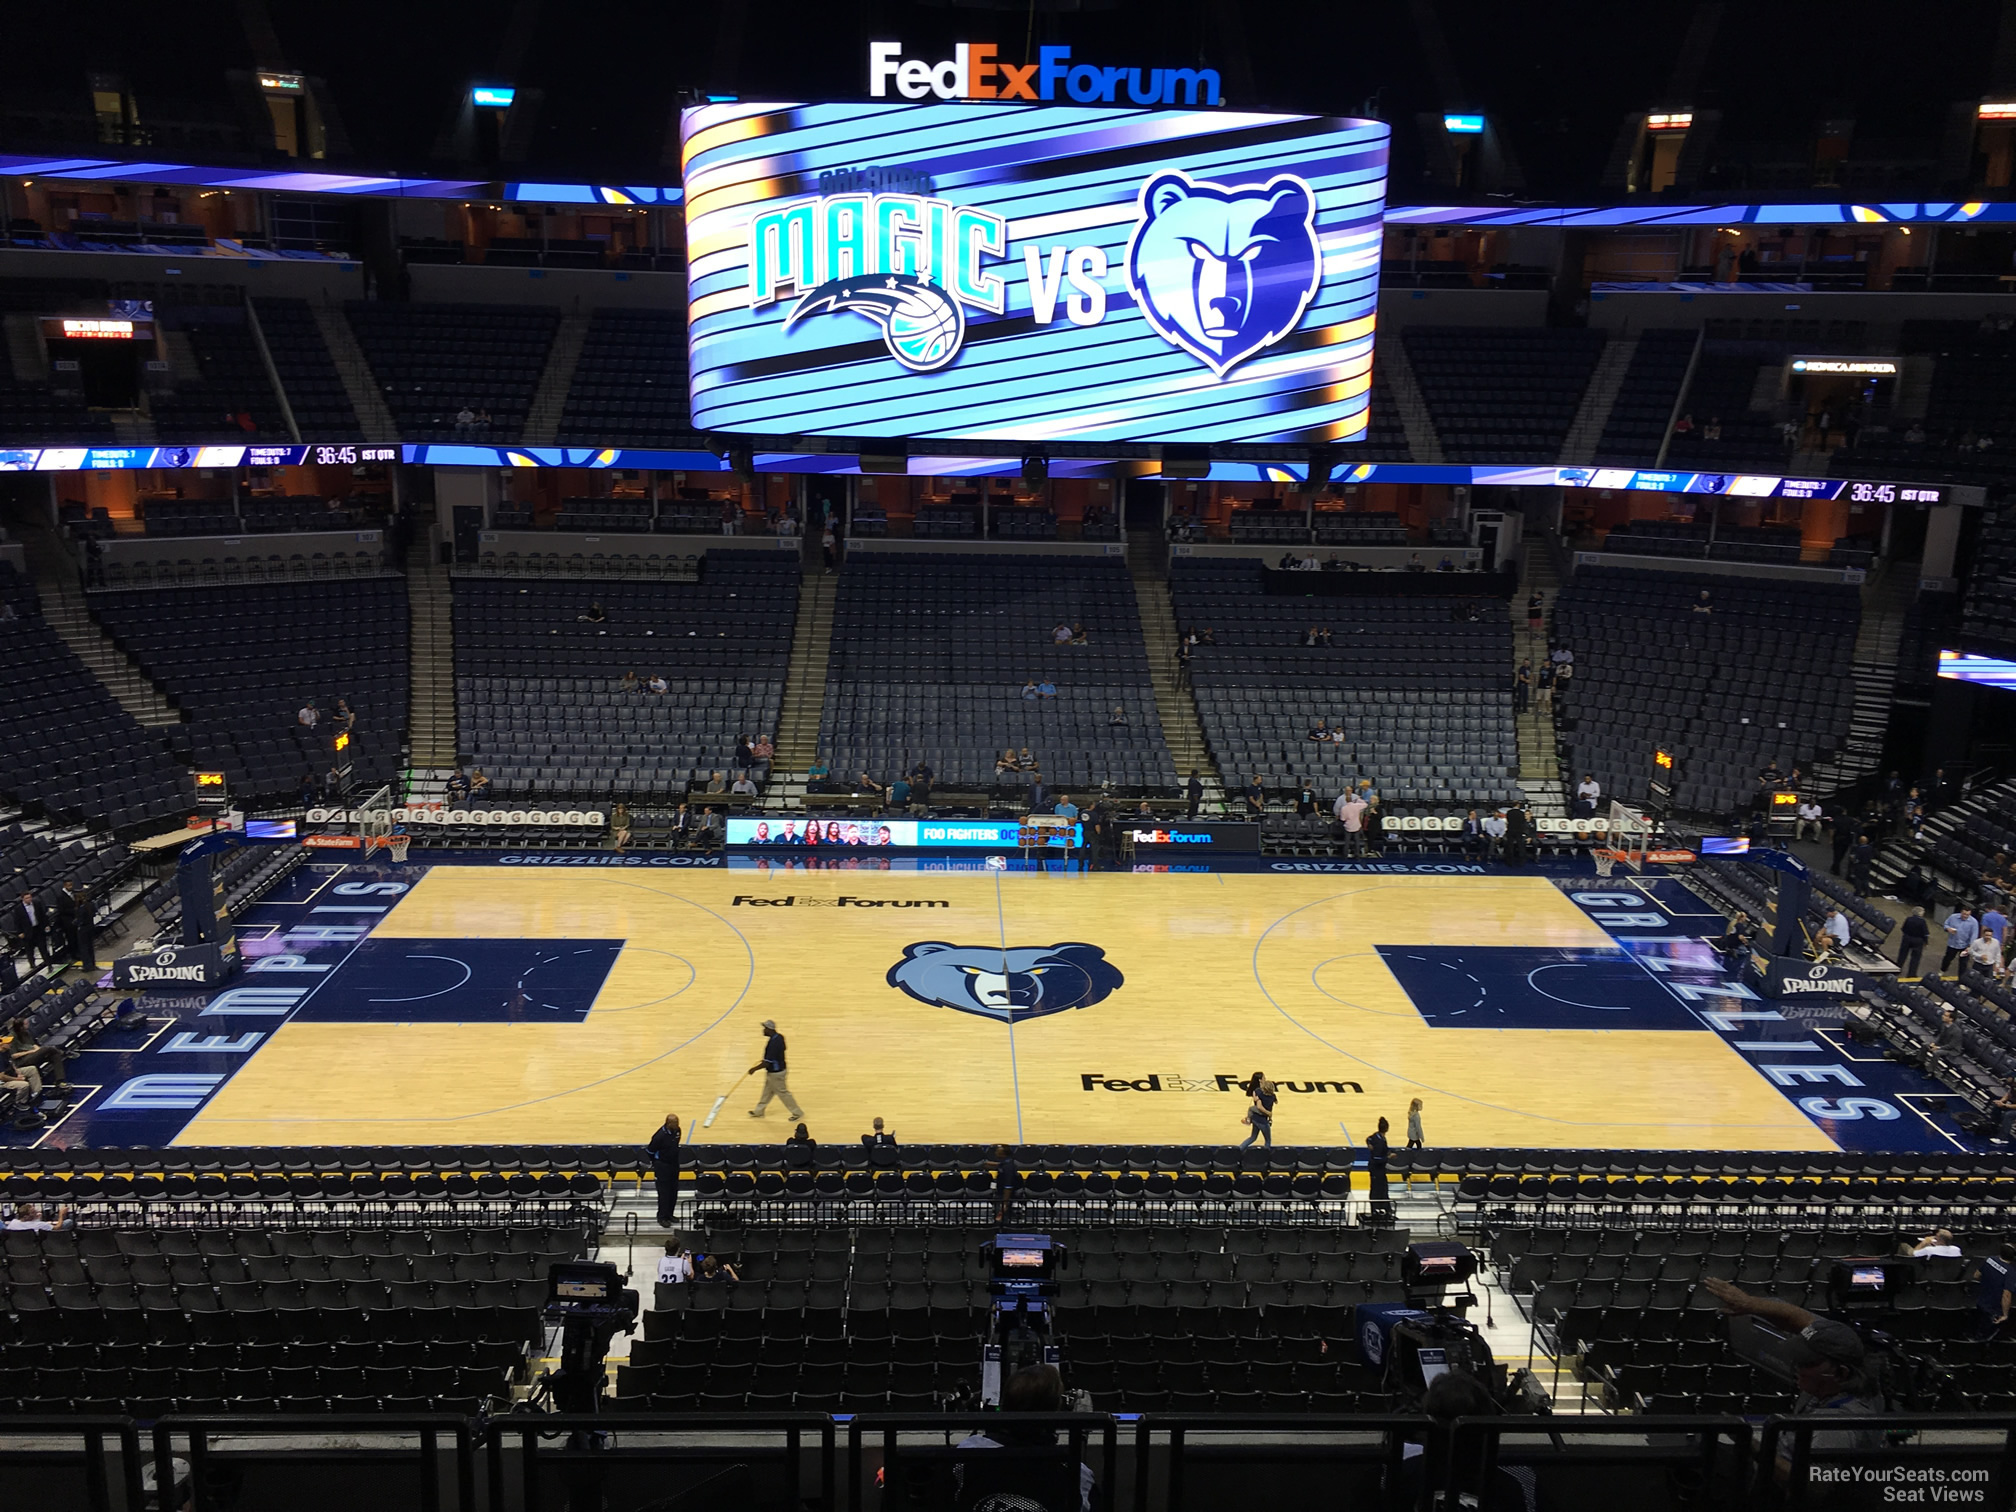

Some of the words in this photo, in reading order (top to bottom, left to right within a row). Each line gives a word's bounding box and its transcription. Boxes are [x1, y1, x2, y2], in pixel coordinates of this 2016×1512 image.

[870, 41, 1220, 106] FedExForum
[819, 165, 932, 194] ORLANDO
[749, 191, 1006, 315] MAGIC
[1023, 245, 1108, 327] VS
[316, 446, 357, 465] 36:45
[378, 449, 396, 461] QTR
[1851, 483, 1896, 503] 36:45
[1918, 491, 1940, 502] QTR
[312, 811, 322, 821] G
[415, 811, 424, 821] G
[435, 812, 445, 822] G
[454, 812, 464, 822] G
[473, 812, 483, 822] G
[493, 811, 502, 821] G
[512, 812, 521, 822] G
[531, 812, 541, 822] G
[550, 812, 560, 823] G
[569, 812, 579, 823] G
[589, 813, 599, 823] G
[1386, 818, 1397, 828] G
[1406, 818, 1417, 828] G
[1426, 818, 1437, 828] G
[1447, 818, 1458, 828] G
[1539, 819, 1549, 829] G
[1558, 820, 1568, 830] G
[1577, 821, 1586, 831] G
[1594, 820, 1604, 830] G
[924, 827, 945, 840] FOO
[947, 828, 998, 840] FIGHTERS
[1133, 829, 1212, 843] FedExForum
[499, 855, 720, 865] GRIZZLIES.COM
[1271, 862, 1486, 873] GRIZZLIES.COM
[732, 895, 949, 907] FedExForum
[129, 964, 206, 982] SPALDING
[1782, 978, 1854, 994] SPALDING
[95, 881, 410, 1111] MEMPHIS
[1570, 892, 1901, 1121] GRIZZLIES
